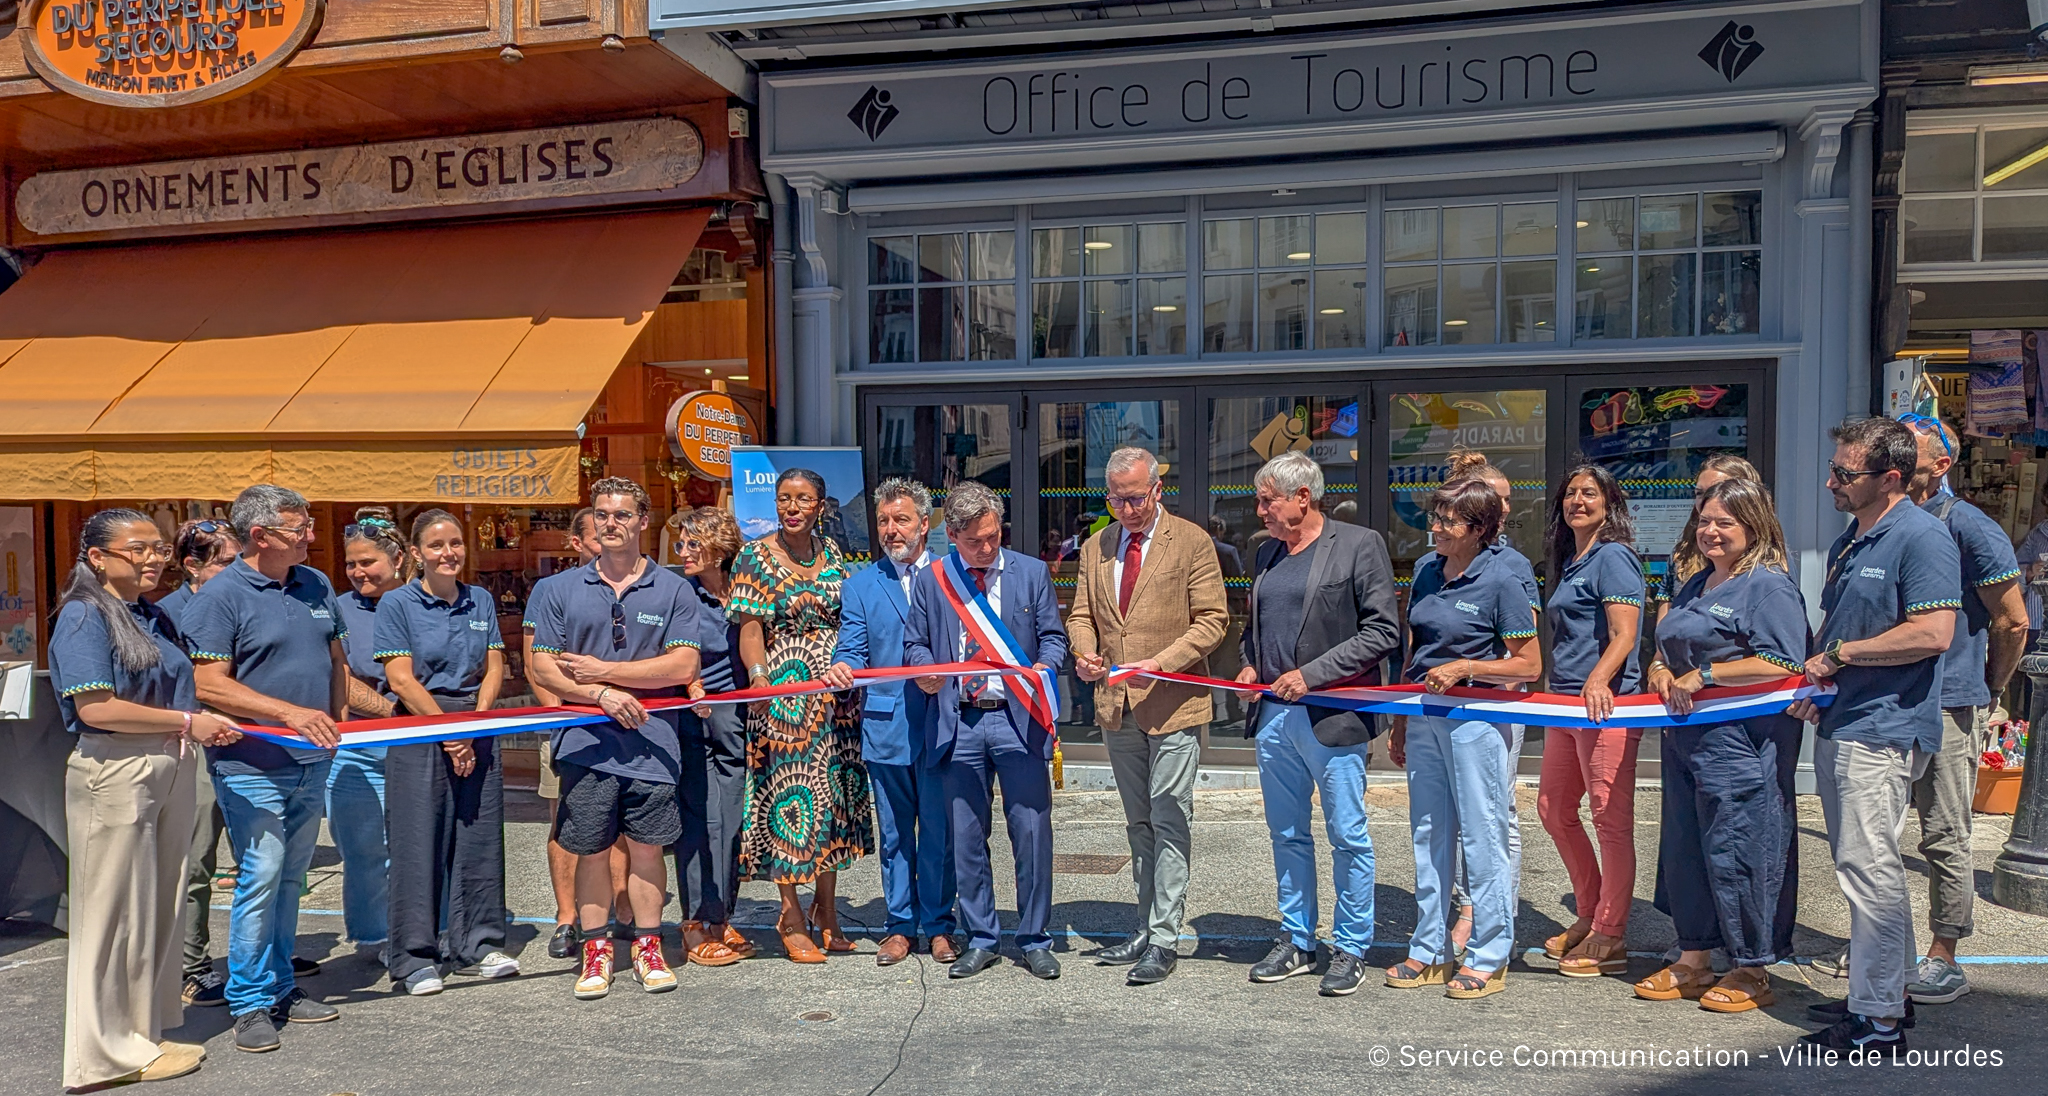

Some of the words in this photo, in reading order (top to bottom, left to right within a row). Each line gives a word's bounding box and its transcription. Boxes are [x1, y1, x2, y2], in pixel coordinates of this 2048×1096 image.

[52, 1, 97, 34] DU
[93, 18, 238, 63] SECOURS
[85, 68, 142, 93] MAISON
[194, 71, 206, 86] &
[210, 50, 257, 82] FILLES
[983, 72, 1149, 136] Office
[1181, 62, 1250, 124] de
[1290, 45, 1598, 115] Tourisme
[81, 162, 321, 218] ORNEMENTS
[389, 137, 614, 194] D'EGLISES
[696, 402, 747, 428] Notre-Dame
[685, 423, 701, 441] DU
[452, 447, 538, 469] OBJETS
[700, 447, 732, 465] SECOU
[436, 474, 553, 497] RELIGIEUX
